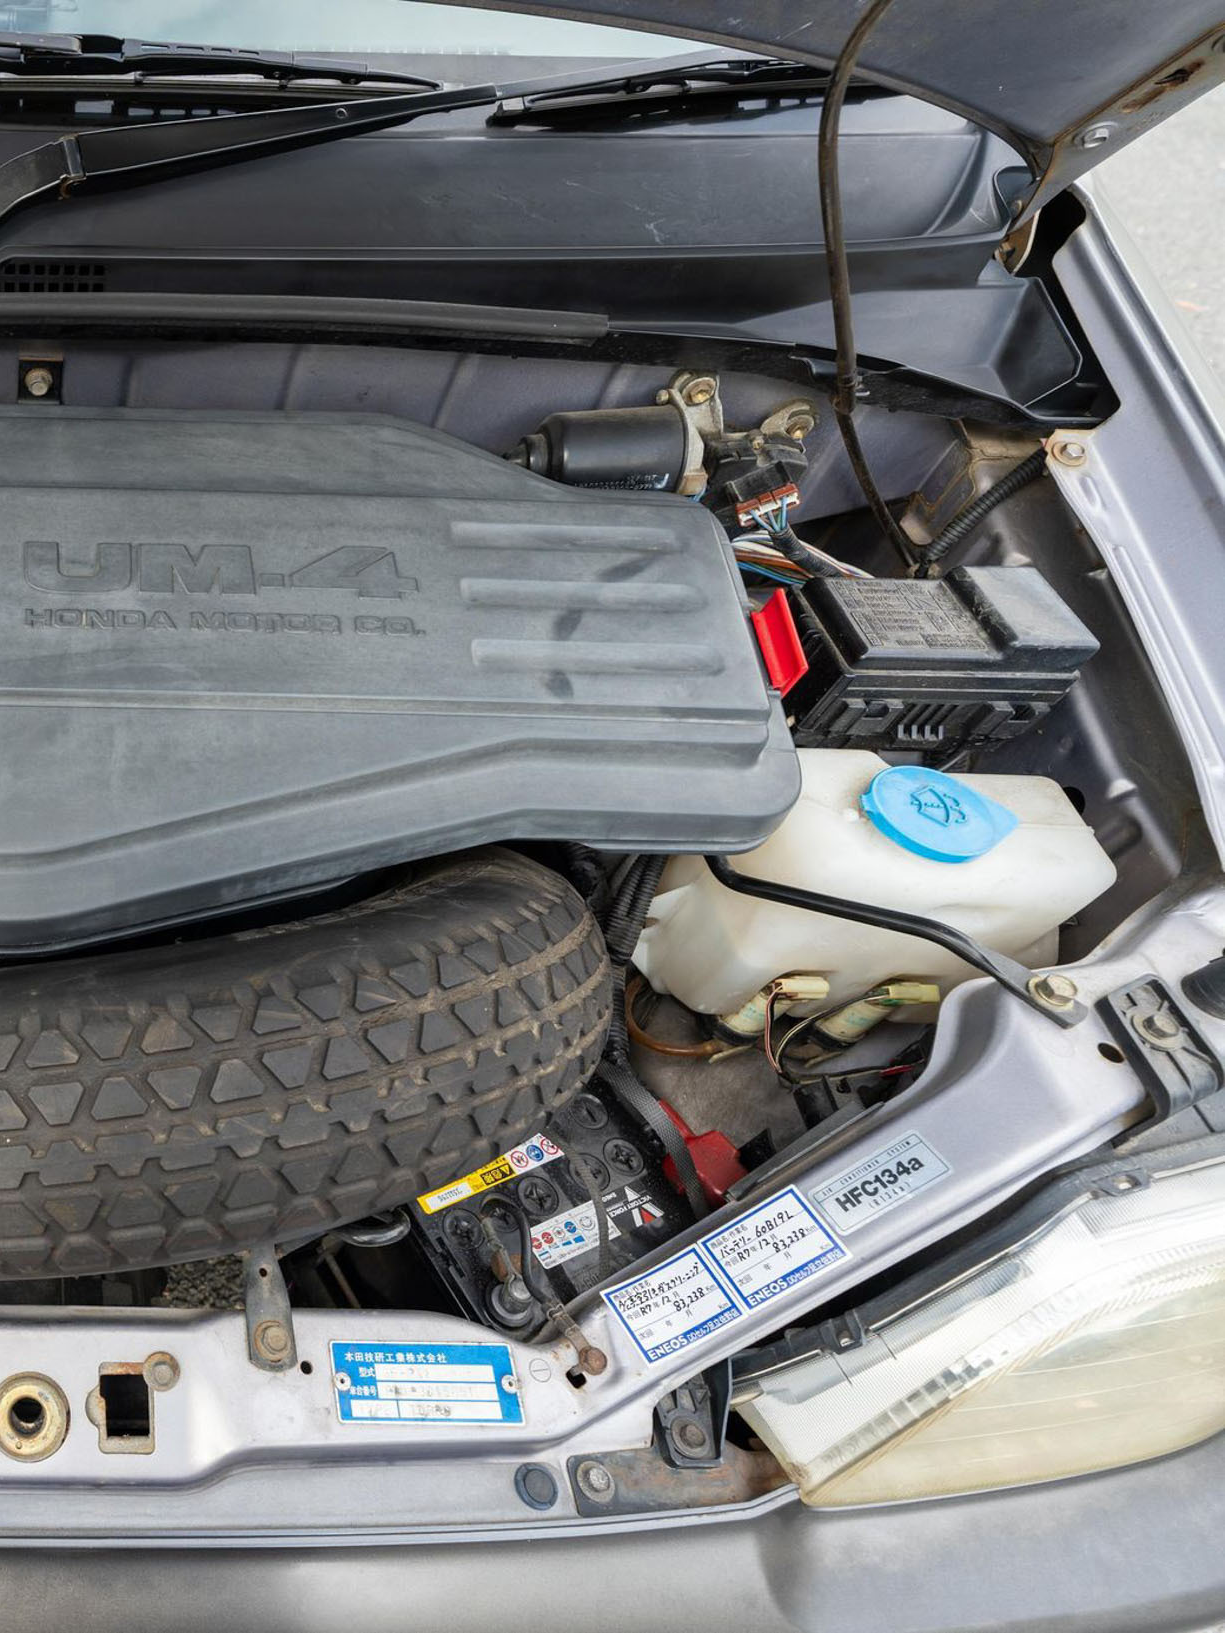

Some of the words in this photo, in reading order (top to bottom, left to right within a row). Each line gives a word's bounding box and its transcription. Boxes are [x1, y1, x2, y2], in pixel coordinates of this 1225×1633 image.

[23, 539, 419, 600] UM-4
[24, 607, 176, 631] HONDA
[192, 611, 341, 635] MOTOR
[835, 1157, 924, 1212] HFC134a
[869, 1181, 911, 1209] (R134a)
[608, 1205, 627, 1217] FORCE
[626, 1193, 652, 1209] VICTORY
[720, 1236, 751, 1258] バッテリー
[755, 1211, 794, 1237] 60B19L
[772, 1228, 805, 1253] 83,238
[736, 1247, 752, 1261] R7
[757, 1237, 770, 1249] 12
[673, 1287, 705, 1312] 83,238
[748, 1278, 787, 1306] ENEOS
[639, 1303, 653, 1316] R7
[659, 1294, 671, 1305] 12
[344, 1352, 448, 1363] 本田技研工業株式会社
[647, 1335, 687, 1360] ENEOS
